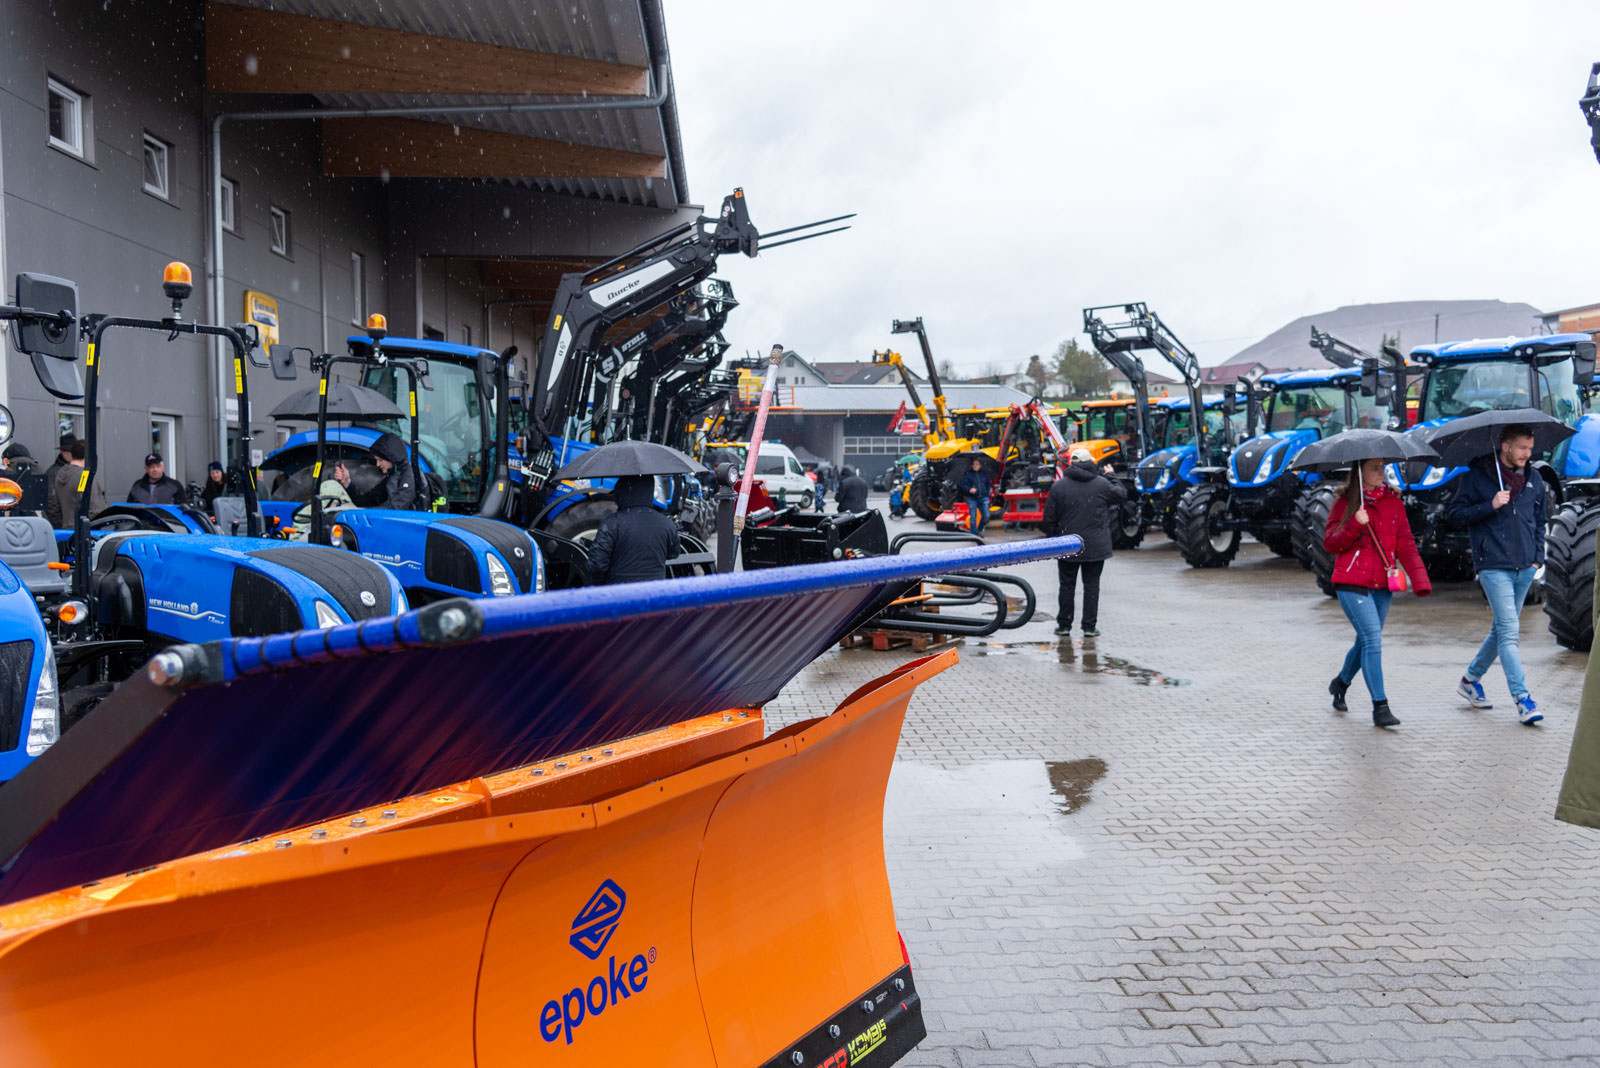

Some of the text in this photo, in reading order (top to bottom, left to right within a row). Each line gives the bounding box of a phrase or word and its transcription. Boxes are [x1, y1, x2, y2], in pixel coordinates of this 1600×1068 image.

[607, 280, 640, 300] Quicke
[149, 598, 190, 612] NEW HOLLAND
